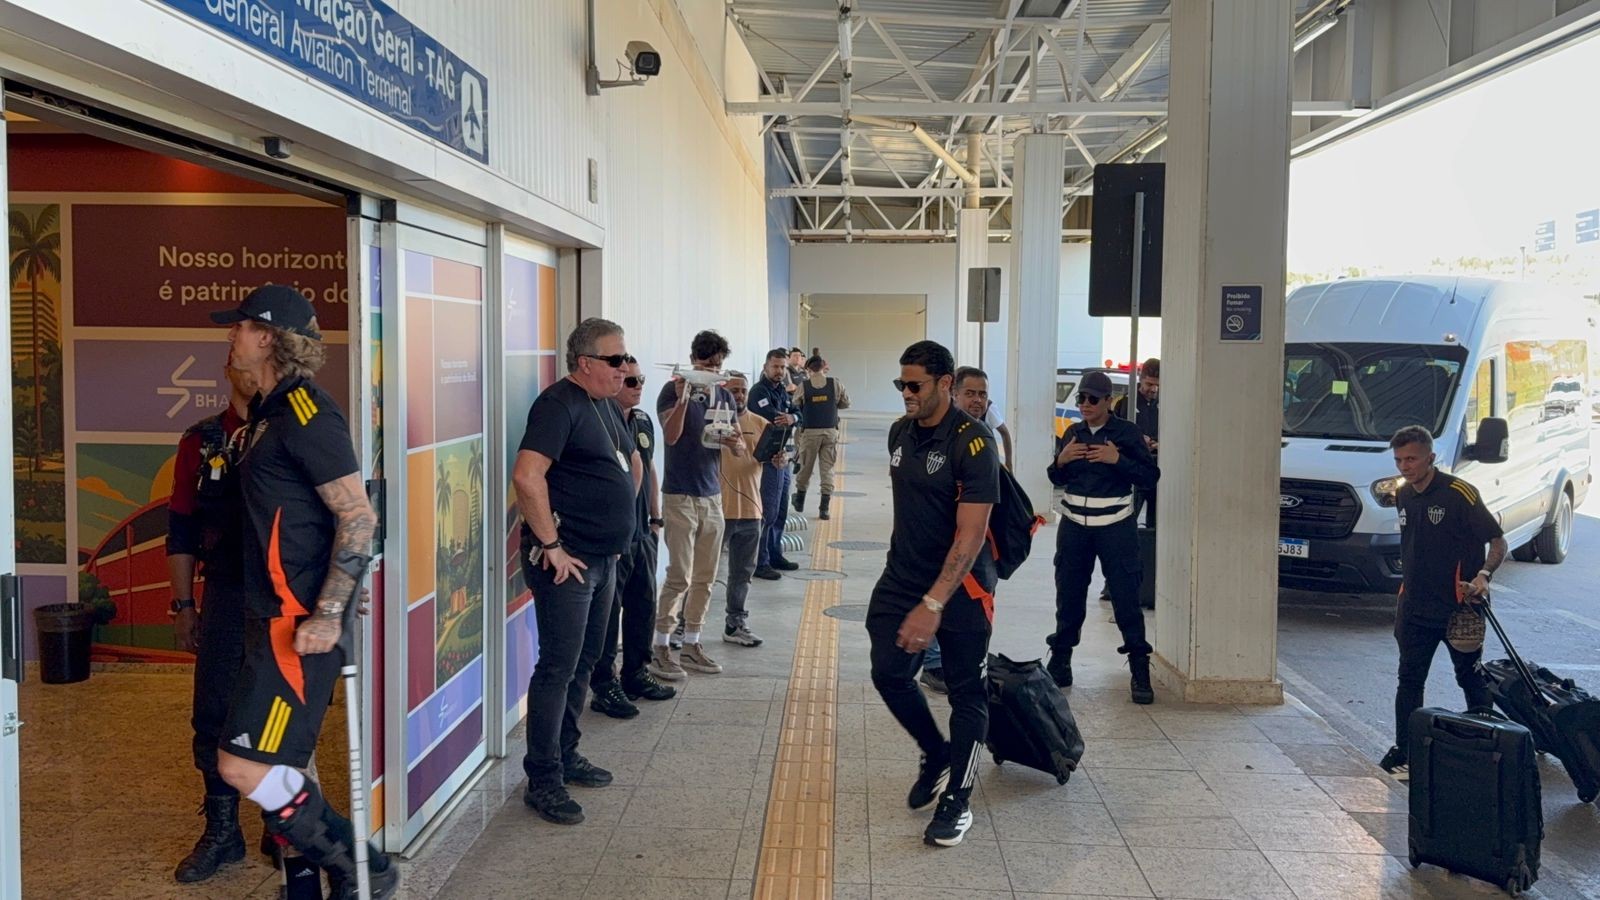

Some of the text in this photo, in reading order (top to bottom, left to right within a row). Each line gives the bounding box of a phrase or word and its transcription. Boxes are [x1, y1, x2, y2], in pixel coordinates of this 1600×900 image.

[290, 18, 354, 85] Aviation
[356, 56, 412, 116] Terminal
[371, 11, 415, 76] Geral
[425, 47, 456, 101] TAG
[159, 246, 348, 270] Nosso horizont
[158, 280, 173, 301] é
[181, 279, 316, 306] patrio
